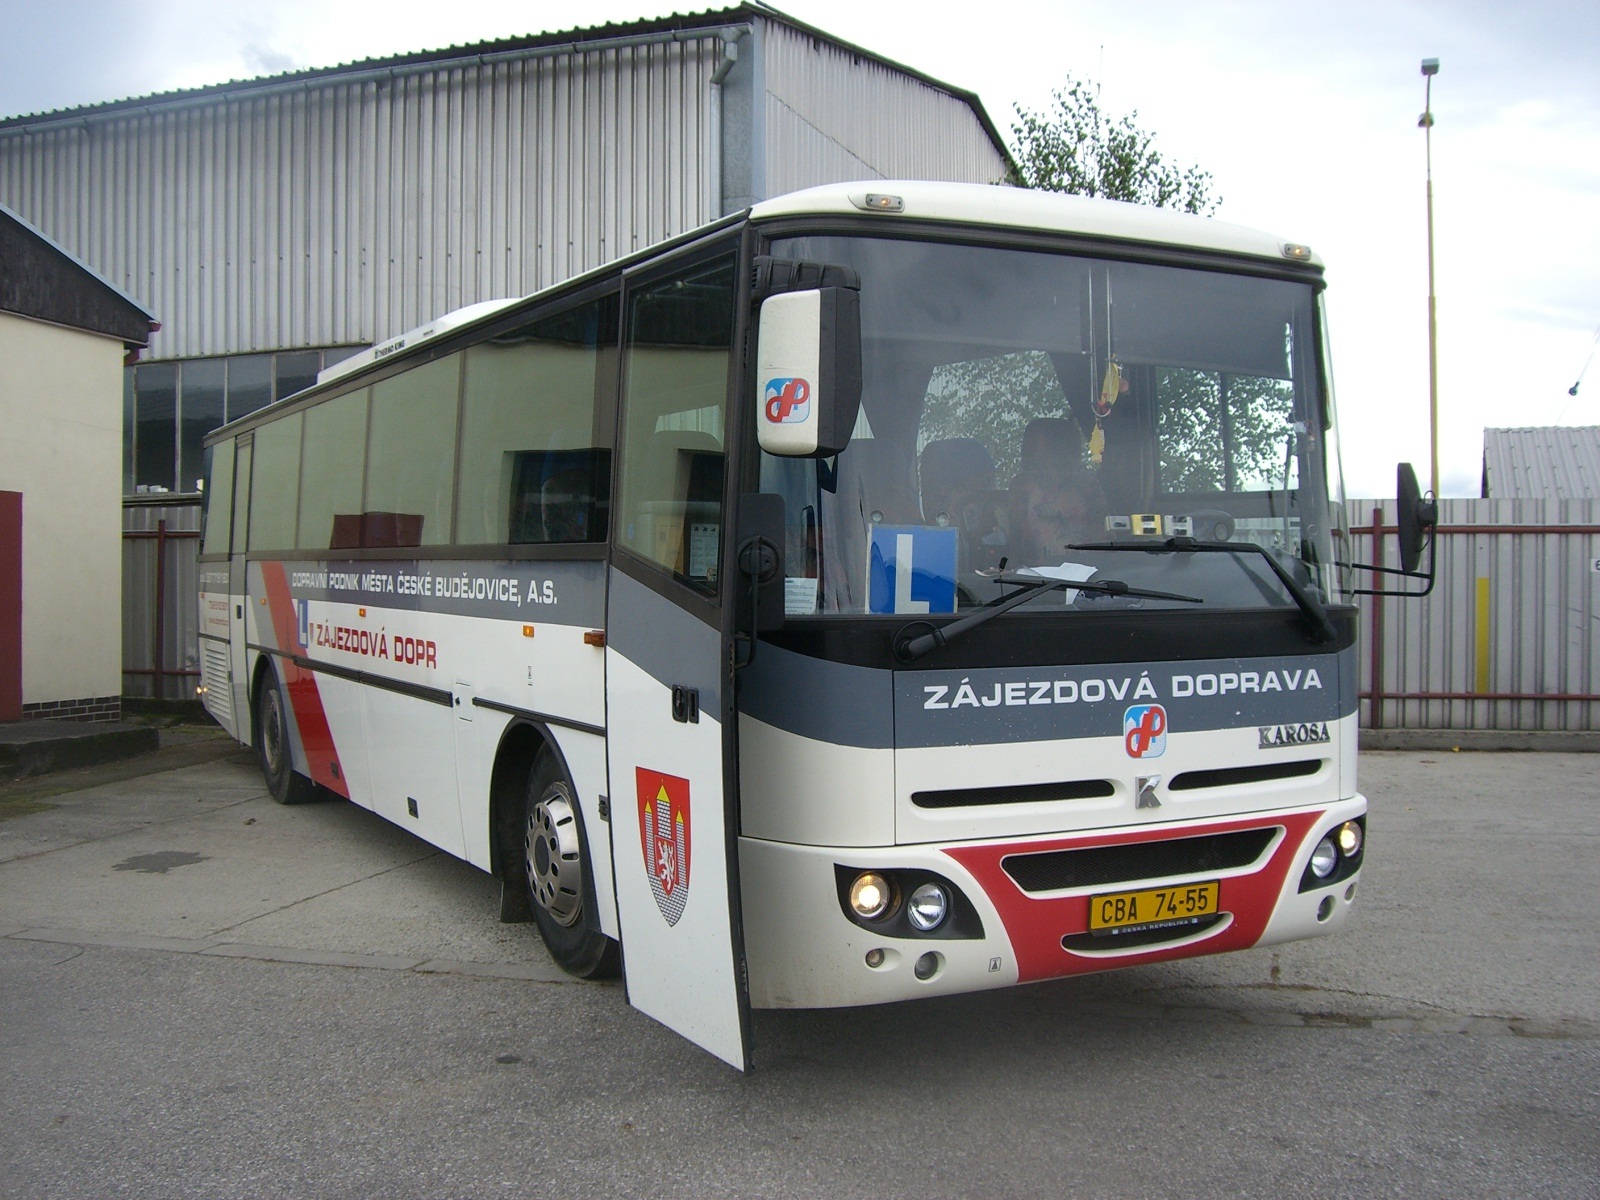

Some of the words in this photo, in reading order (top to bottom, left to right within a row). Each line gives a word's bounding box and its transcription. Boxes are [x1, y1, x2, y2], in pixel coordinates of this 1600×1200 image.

[292, 568, 328, 589] DOPRAVNÍ
[329, 572, 360, 591] PODNIK
[361, 569, 395, 594] MĚSTA
[397, 570, 432, 596] ČESKÉ
[435, 571, 522, 607] BUDĚJOVICE,
[526, 579, 558, 605] A.S.
[894, 533, 930, 614] L
[316, 617, 389, 660] ZÁJEZDOVÁ
[394, 635, 437, 669] DOPR
[923, 671, 1158, 710] ZÁJEZDOVÁ
[1171, 668, 1322, 698] DOPRAVA
[1258, 721, 1331, 746] KAROSA
[1101, 896, 1138, 924] CBA
[1154, 887, 1209, 918] 74-55
[1149, 919, 1189, 930] REPUBLIKA
